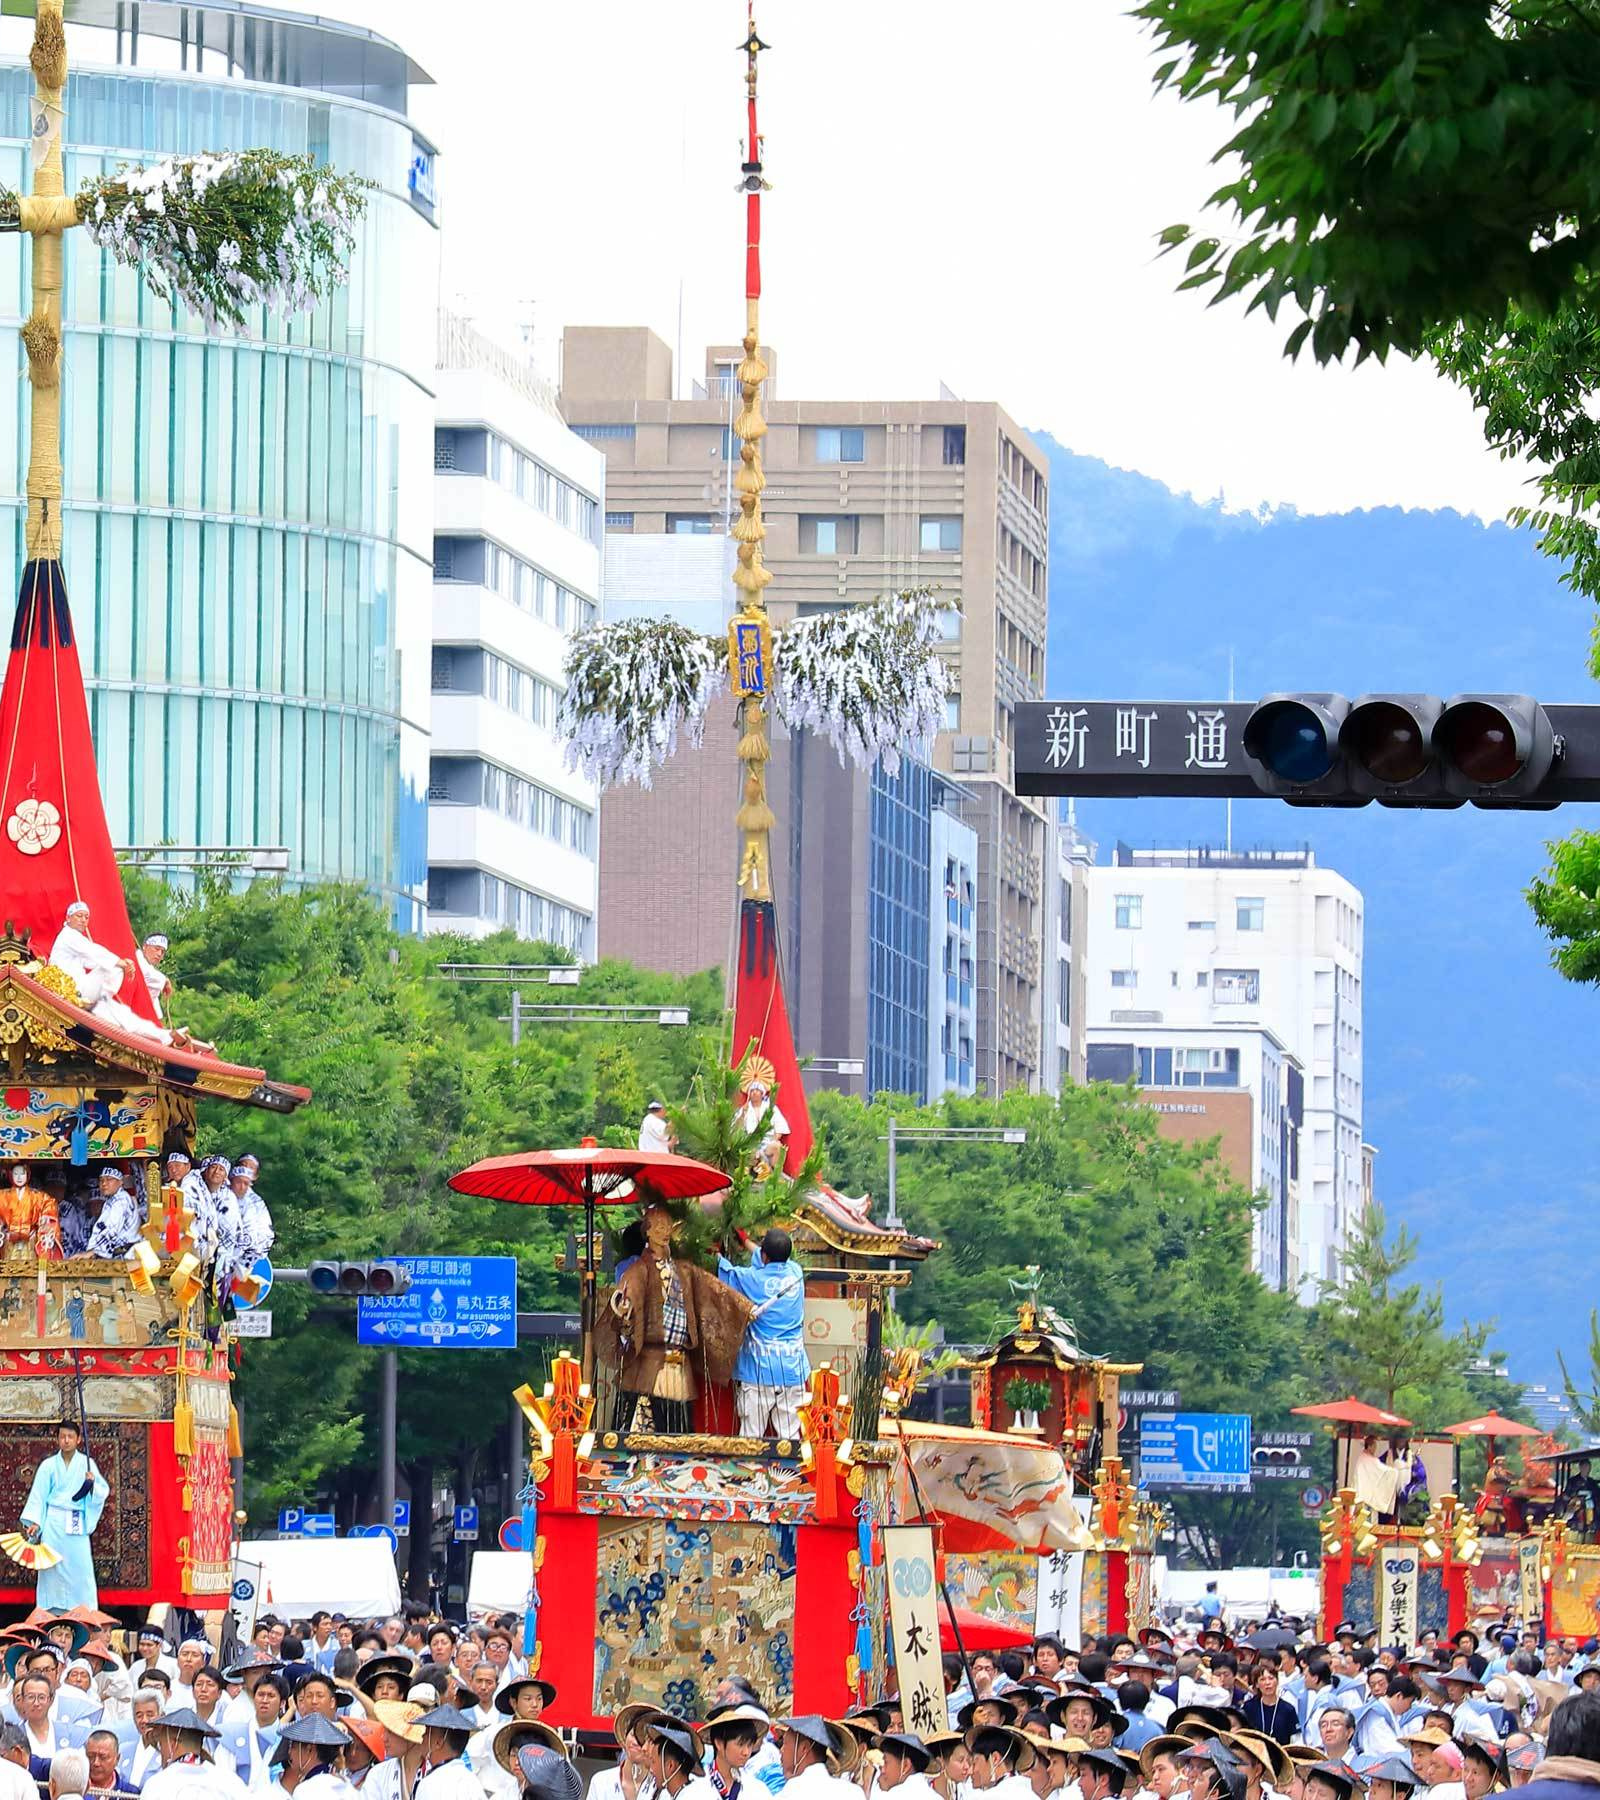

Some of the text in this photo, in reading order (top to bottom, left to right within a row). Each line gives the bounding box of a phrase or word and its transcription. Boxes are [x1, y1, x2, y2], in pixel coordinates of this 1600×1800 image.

[1043, 706, 1230, 769] 新町通
[403, 1260, 472, 1276] 河原町御池
[456, 1295, 512, 1311] 烏丸五条
[432, 1307, 443, 1317] 37
[455, 1311, 512, 1322] Karasumagojo
[423, 1324, 451, 1335] 烏丸通
[471, 1323, 485, 1333] 367
[285, 1509, 299, 1530] P
[394, 1504, 406, 1521] P
[461, 1508, 474, 1527] P
